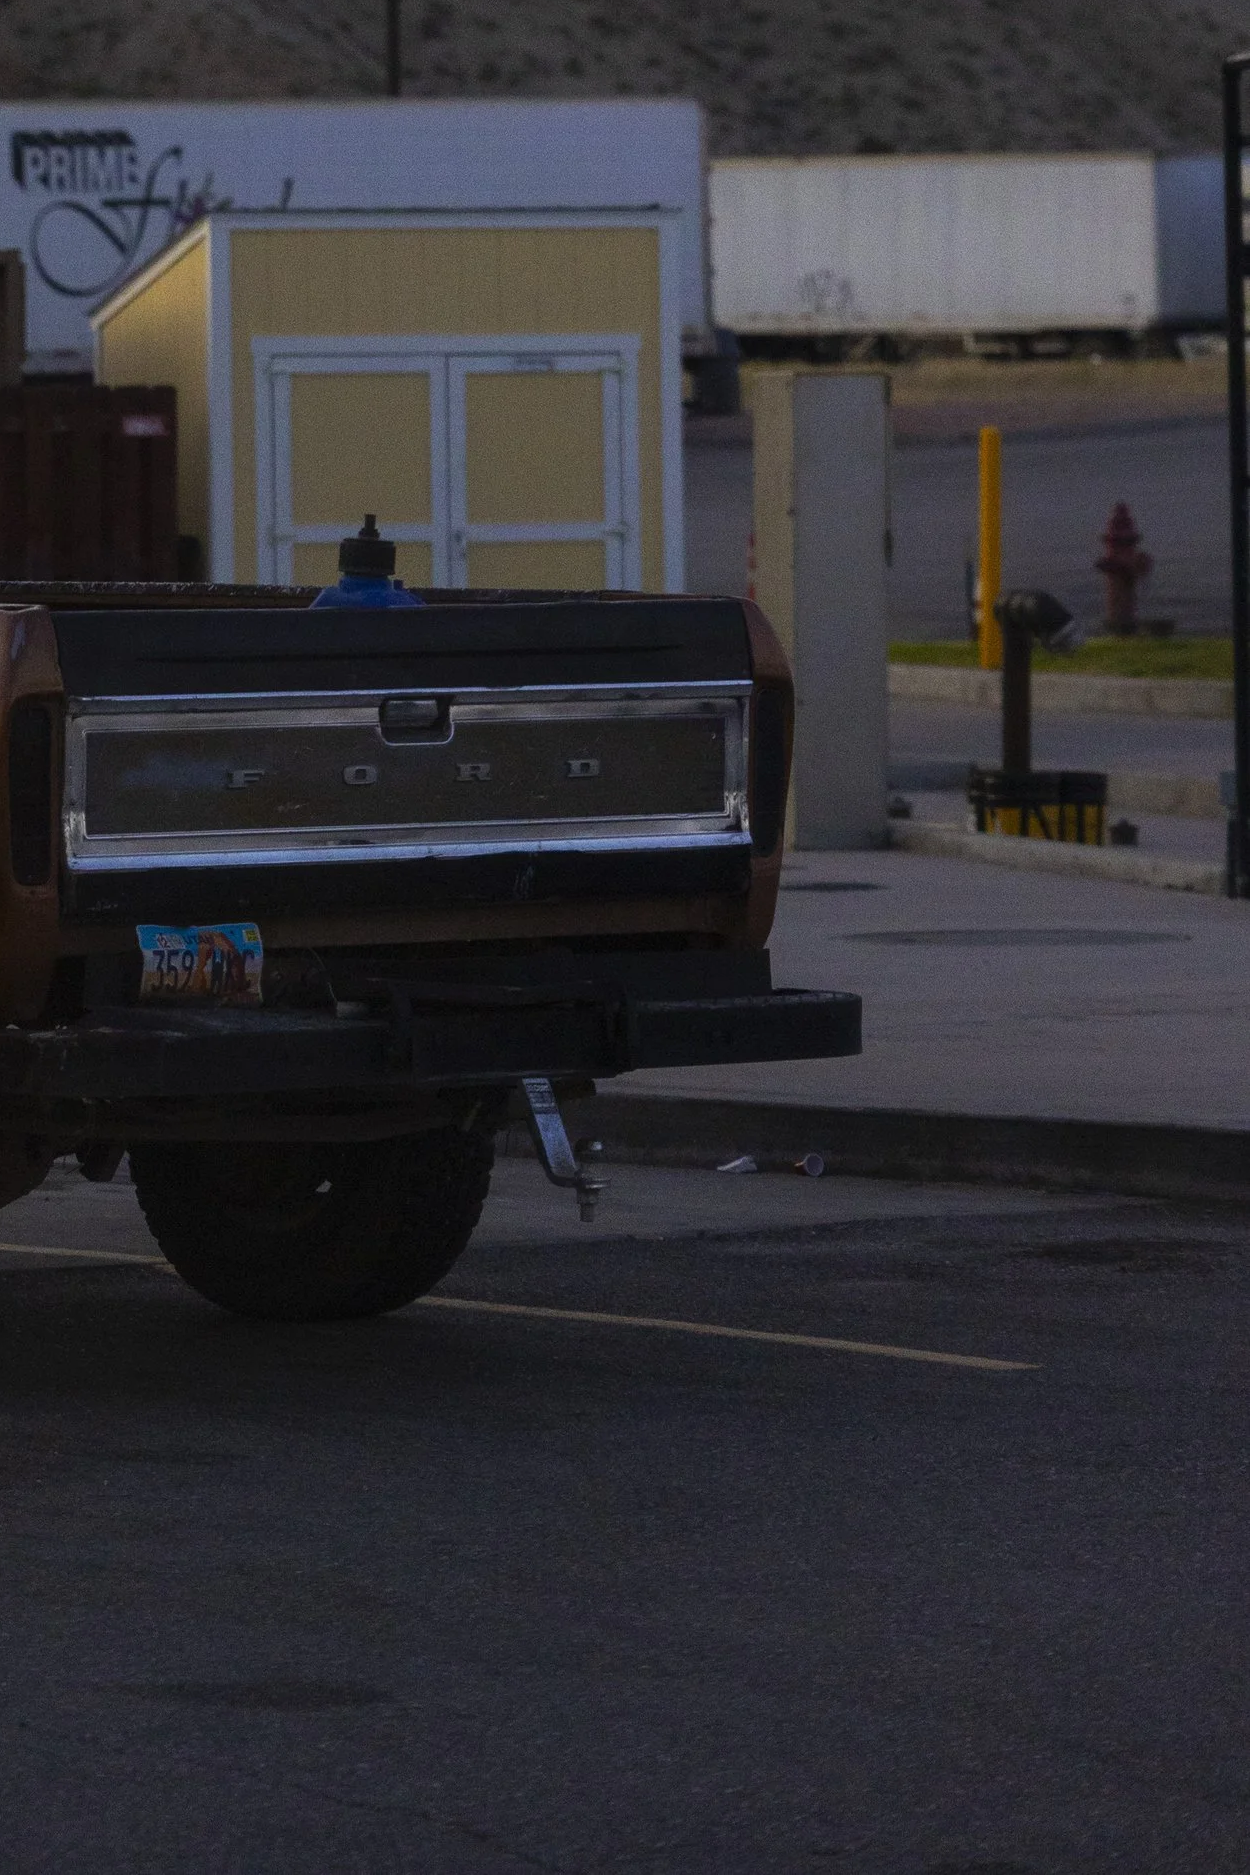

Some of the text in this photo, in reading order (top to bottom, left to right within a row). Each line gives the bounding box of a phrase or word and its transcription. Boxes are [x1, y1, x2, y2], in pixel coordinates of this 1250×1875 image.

[16, 134, 141, 192] PRIME
[225, 757, 600, 790] FORD
[152, 949, 194, 993] 359
